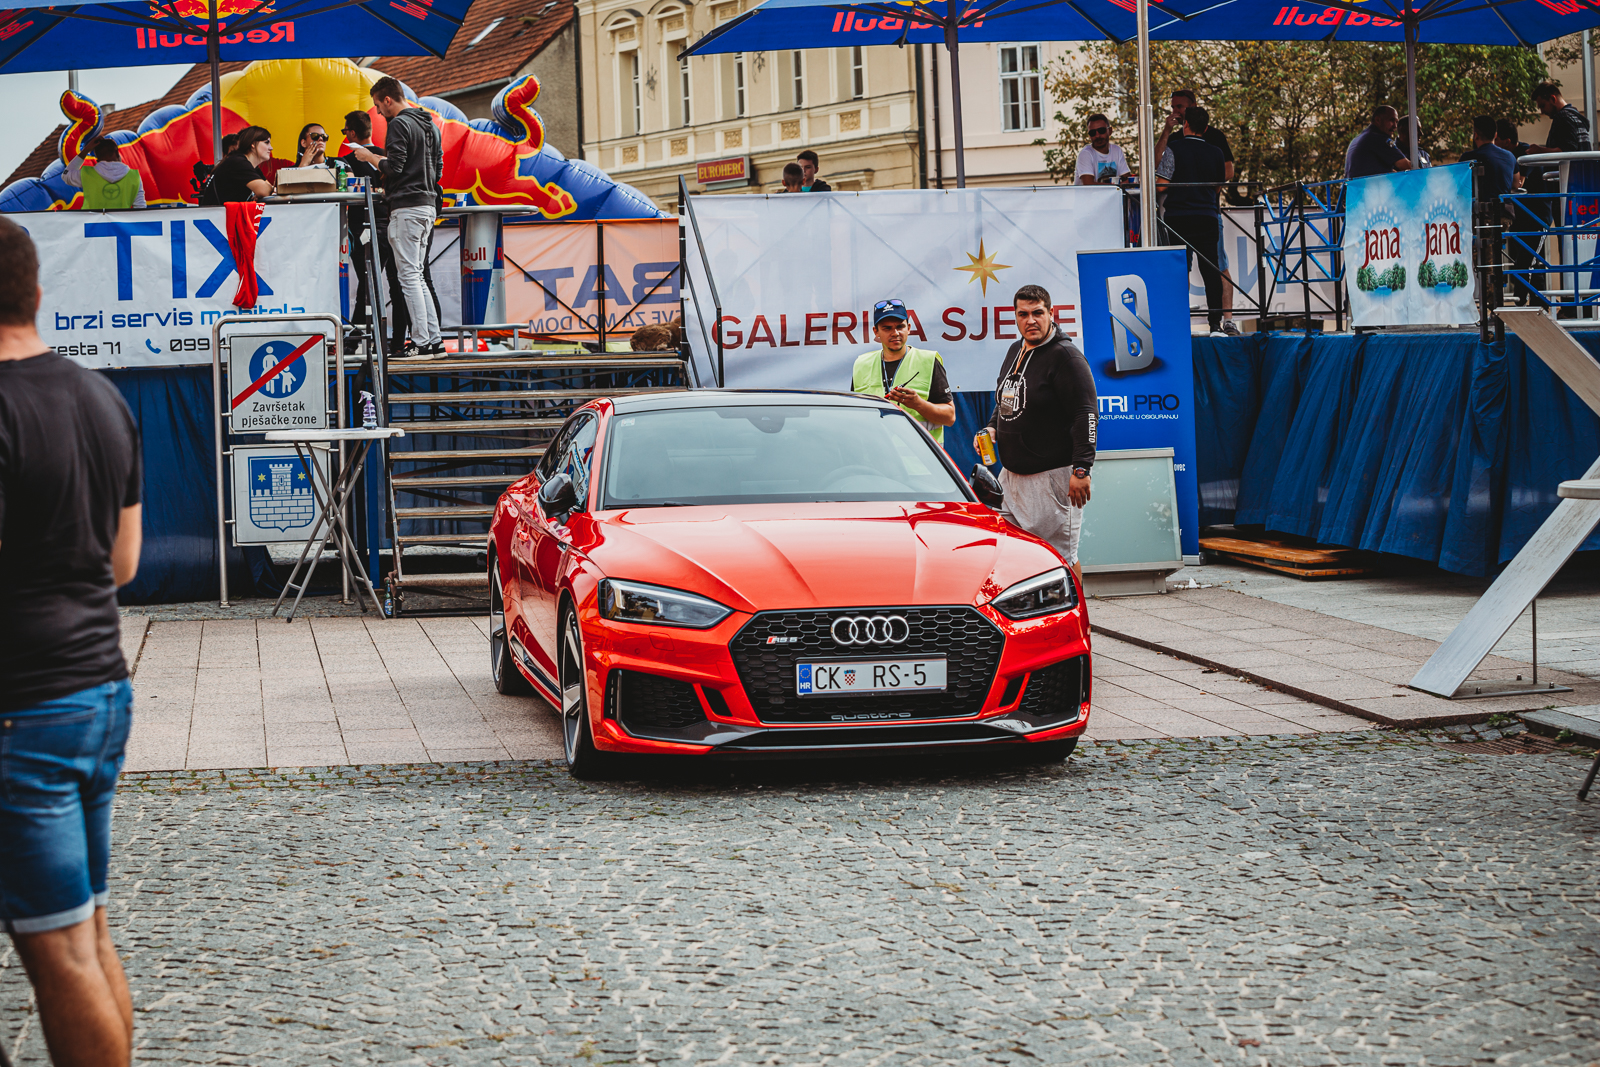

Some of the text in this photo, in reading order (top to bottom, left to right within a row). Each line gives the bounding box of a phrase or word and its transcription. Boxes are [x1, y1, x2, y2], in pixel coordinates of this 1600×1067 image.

[698, 161, 745, 180] EUROHERC
[1361, 227, 1402, 269] jana
[1421, 221, 1462, 265] jana
[84, 216, 275, 301] TIX
[463, 247, 487, 262] Bull
[55, 310, 104, 331] brzi
[111, 307, 194, 329] servis
[711, 309, 929, 350] GALERIA
[102, 341, 122, 355] 71
[169, 338, 211, 352] 099
[252, 400, 306, 413] Završetak
[1134, 394, 1180, 411] PRO
[241, 414, 318, 429] pješačke zone
[815, 663, 927, 690] ČK RS-5
[799, 682, 812, 690] HR
[831, 712, 912, 722] quattro
